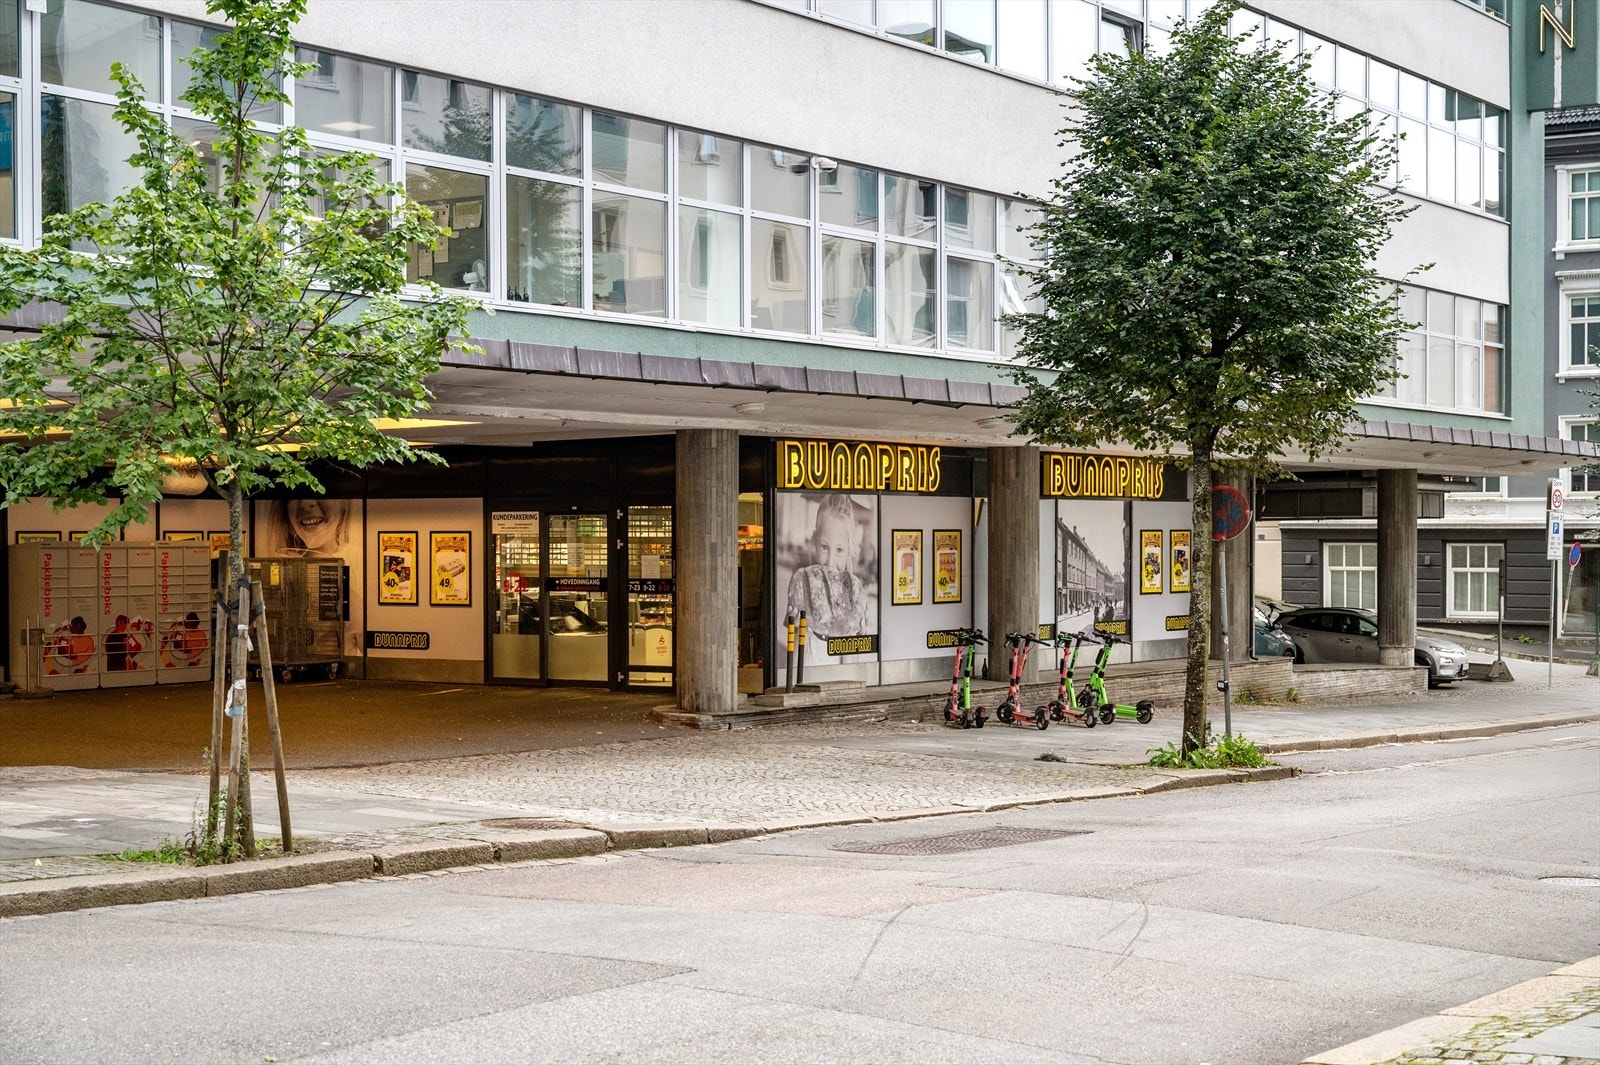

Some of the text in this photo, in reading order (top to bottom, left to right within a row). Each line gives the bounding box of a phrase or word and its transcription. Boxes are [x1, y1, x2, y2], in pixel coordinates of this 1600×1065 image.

[1540, 0, 1576, 53] N
[784, 440, 941, 492] BUNNPRIS
[1050, 455, 1164, 499] BUNNPRIS
[1554, 494, 1561, 504] 30
[44, 552, 52, 618] Pakkeboks
[104, 552, 112, 616] Pakkeboks
[503, 579, 528, 592] 9-22
[374, 633, 427, 648] BUNNPRIS
[828, 637, 872, 654] BUNNPRIS
